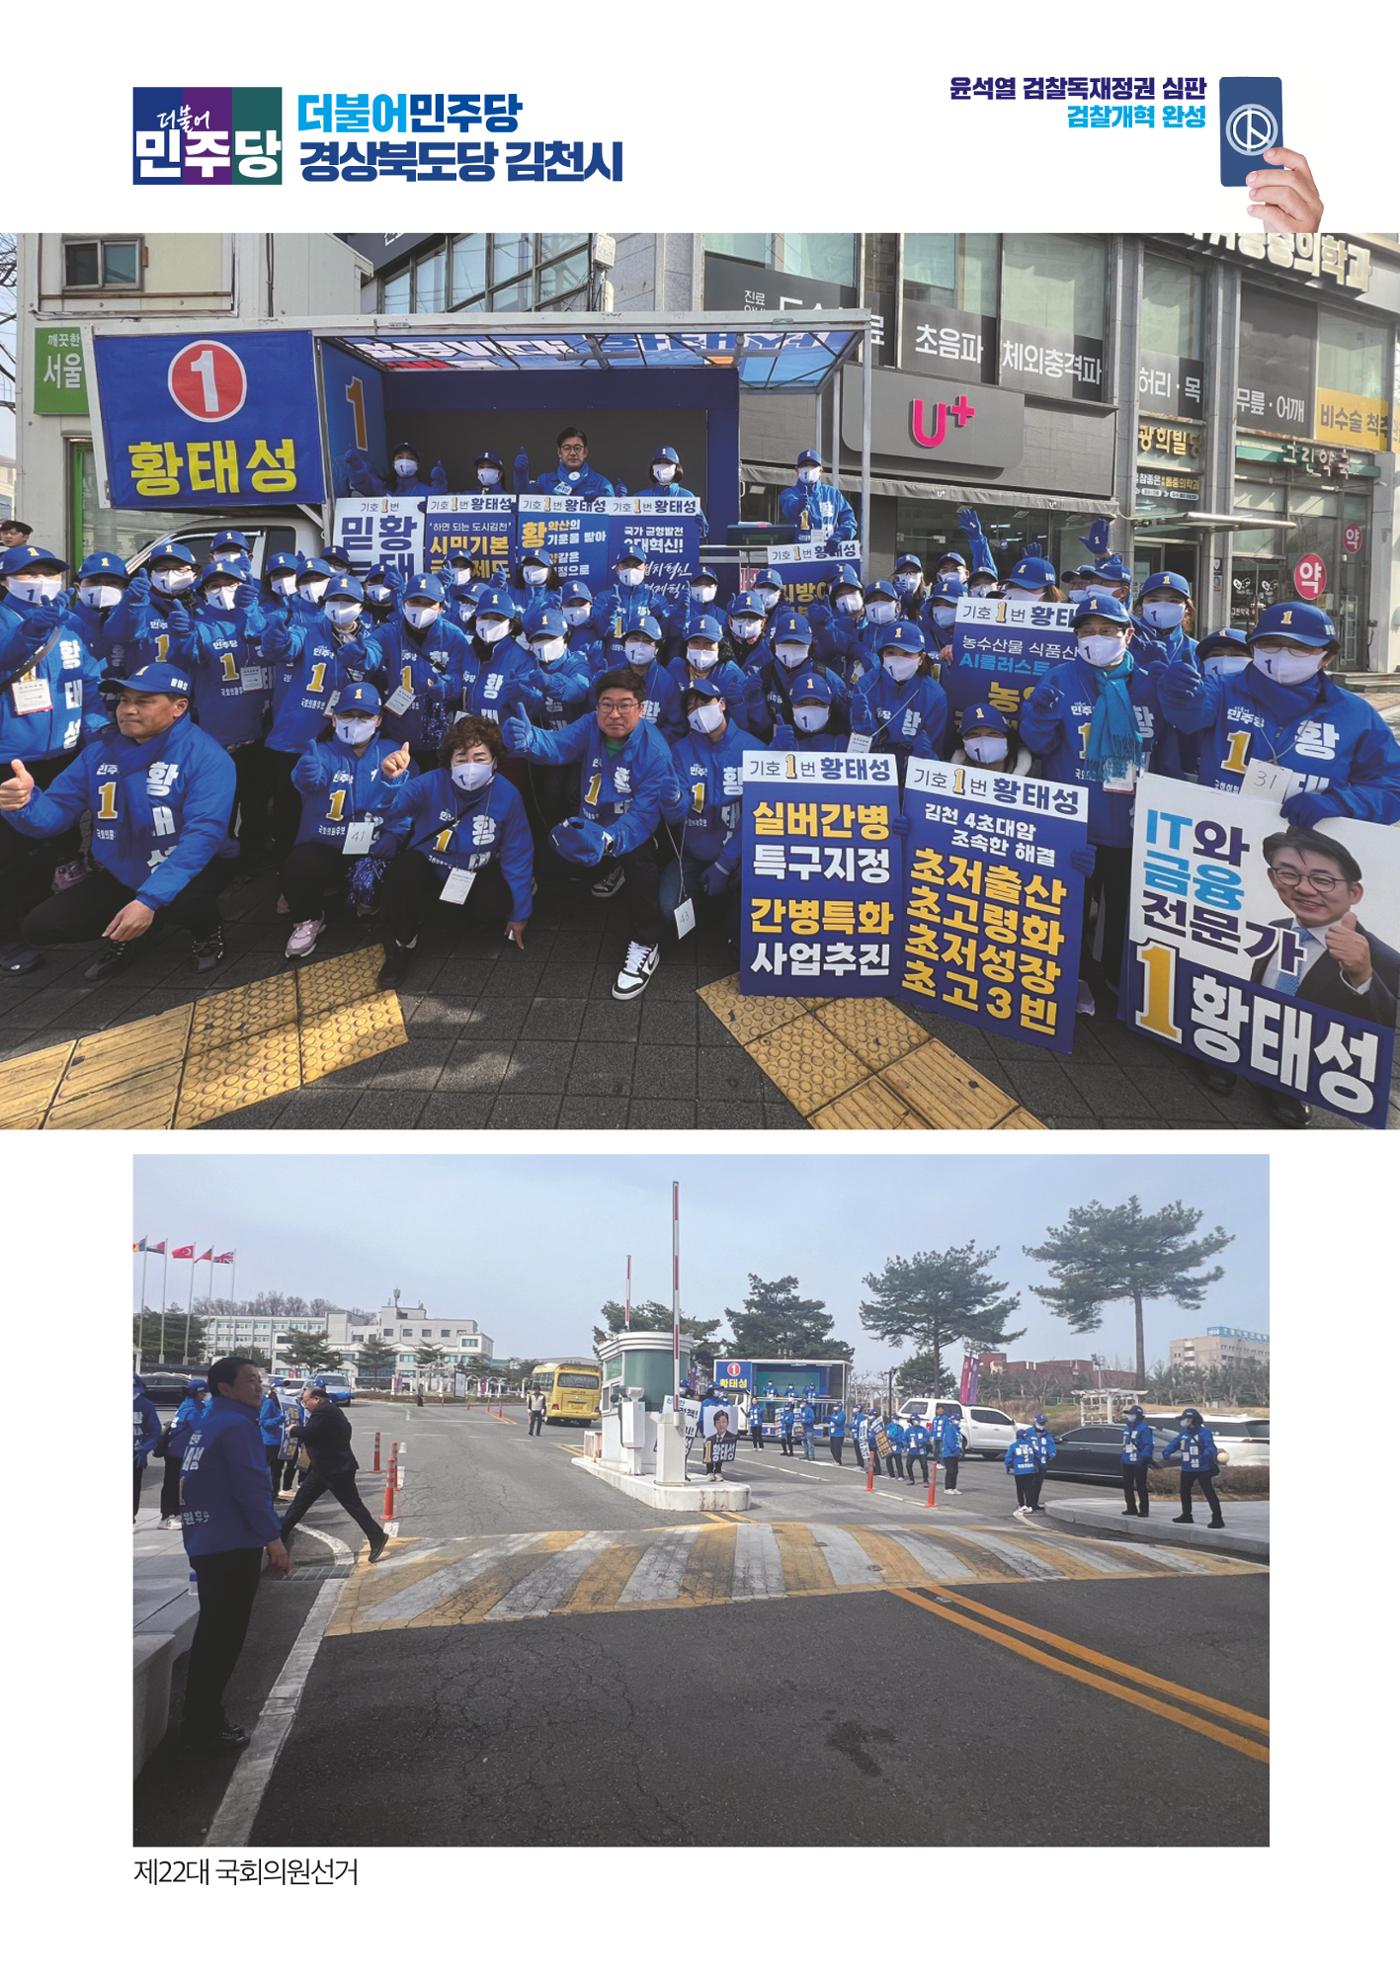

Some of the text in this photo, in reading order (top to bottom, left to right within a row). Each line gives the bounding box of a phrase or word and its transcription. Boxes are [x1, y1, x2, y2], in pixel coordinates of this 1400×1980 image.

[744, 289, 766, 306] 진료
[47, 333, 81, 348] 깨끗한
[915, 323, 984, 364] 초음파
[1002, 339, 1102, 385] 체외충격파
[43, 352, 82, 390] 서울
[189, 350, 221, 413] 1
[345, 375, 369, 451] 1
[912, 395, 976, 448] U+
[1320, 404, 1363, 433] 비수술
[127, 438, 298, 497] 황태성
[360, 502, 379, 513] 기호
[431, 501, 449, 511] 기호
[471, 497, 512, 511] 황태성
[522, 500, 542, 510] 기호
[564, 499, 607, 513] 황태성
[613, 502, 632, 512] 기호
[654, 499, 696, 514] 황태성
[452, 522, 470, 532] 되는
[547, 530, 606, 546] 기운을 받아
[623, 526, 684, 537] 국가 균형발전
[1345, 528, 1360, 548] 약
[28, 548, 39, 556] 1
[102, 558, 109, 566] 1
[772, 550, 792, 561] 기호
[1018, 565, 1026, 573] 1
[1163, 576, 1170, 584] 1
[1299, 561, 1322, 595] 약
[420, 579, 426, 588] 1
[492, 595, 498, 603] 1
[1090, 600, 1097, 609] 1
[542, 616, 548, 624] 1
[790, 620, 795, 629] 1
[962, 605, 991, 621] 기호
[1281, 611, 1292, 624] 1
[895, 628, 901, 638] 1
[154, 634, 170, 662] 1
[962, 635, 1024, 655] 농수산물
[220, 653, 240, 682] 1
[306, 662, 327, 693] 1
[355, 689, 361, 698] 1
[807, 679, 814, 688] 1
[976, 708, 984, 718] 1
[750, 757, 781, 777] 기호
[820, 757, 891, 781] 황태성
[1253, 772, 1277, 789] 31
[97, 781, 118, 819] 1
[584, 773, 602, 807] 1
[691, 782, 706, 814] 1
[913, 767, 948, 789] 기호
[992, 779, 1080, 816] 황태성
[326, 789, 346, 822] 1
[924, 803, 958, 826] 김천
[753, 802, 890, 840] 실버간병
[951, 829, 1056, 868] 조속한 해결
[1145, 808, 1250, 868] IT와
[753, 845, 891, 884] 특구지정
[910, 847, 1068, 916] 초저출산
[1143, 850, 1245, 912] 금융
[750, 898, 894, 936] 간병특화
[906, 885, 1065, 956] 초고령화
[1140, 890, 1308, 978] 전문가
[750, 943, 891, 977] 사업추진
[904, 922, 1061, 996] 초저성장
[1190, 974, 1379, 1115] 황태성
[719, 1378, 748, 1389] 황태성
